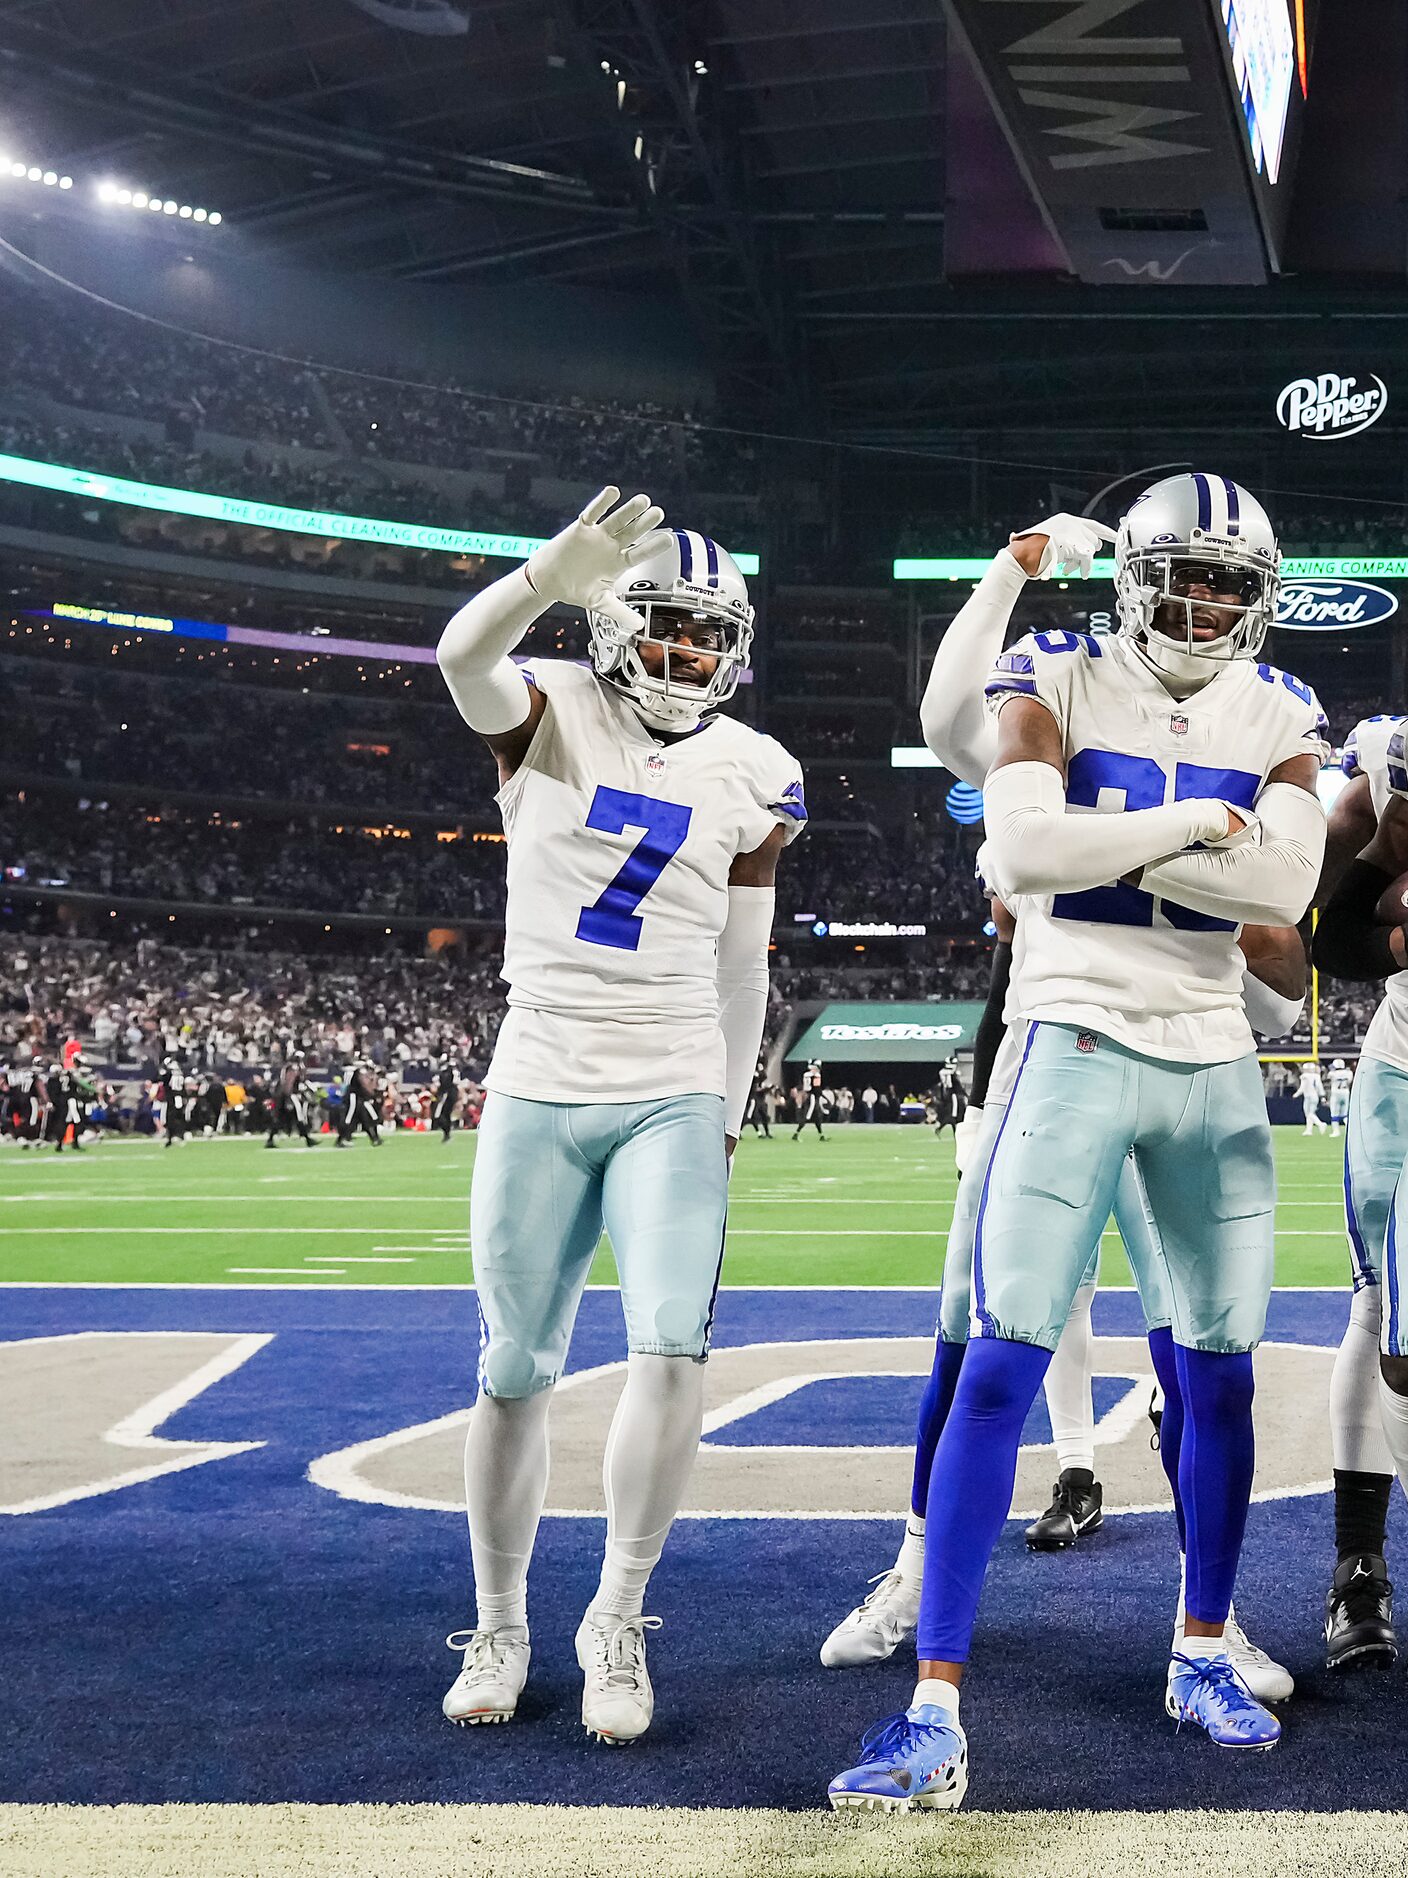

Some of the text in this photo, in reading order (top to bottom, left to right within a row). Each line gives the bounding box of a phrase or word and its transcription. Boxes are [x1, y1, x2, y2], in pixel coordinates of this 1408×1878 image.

[1316, 373, 1357, 404] Dr
[221, 501, 249, 519] THE
[255, 507, 324, 530] OFFICIAL
[331, 519, 412, 542] CLEANING
[416, 530, 496, 552] COMPANY
[1280, 561, 1336, 575] EANING
[1277, 585, 1368, 622] Ford
[574, 784, 693, 951] 7
[828, 921, 927, 937] Blockchain.com
